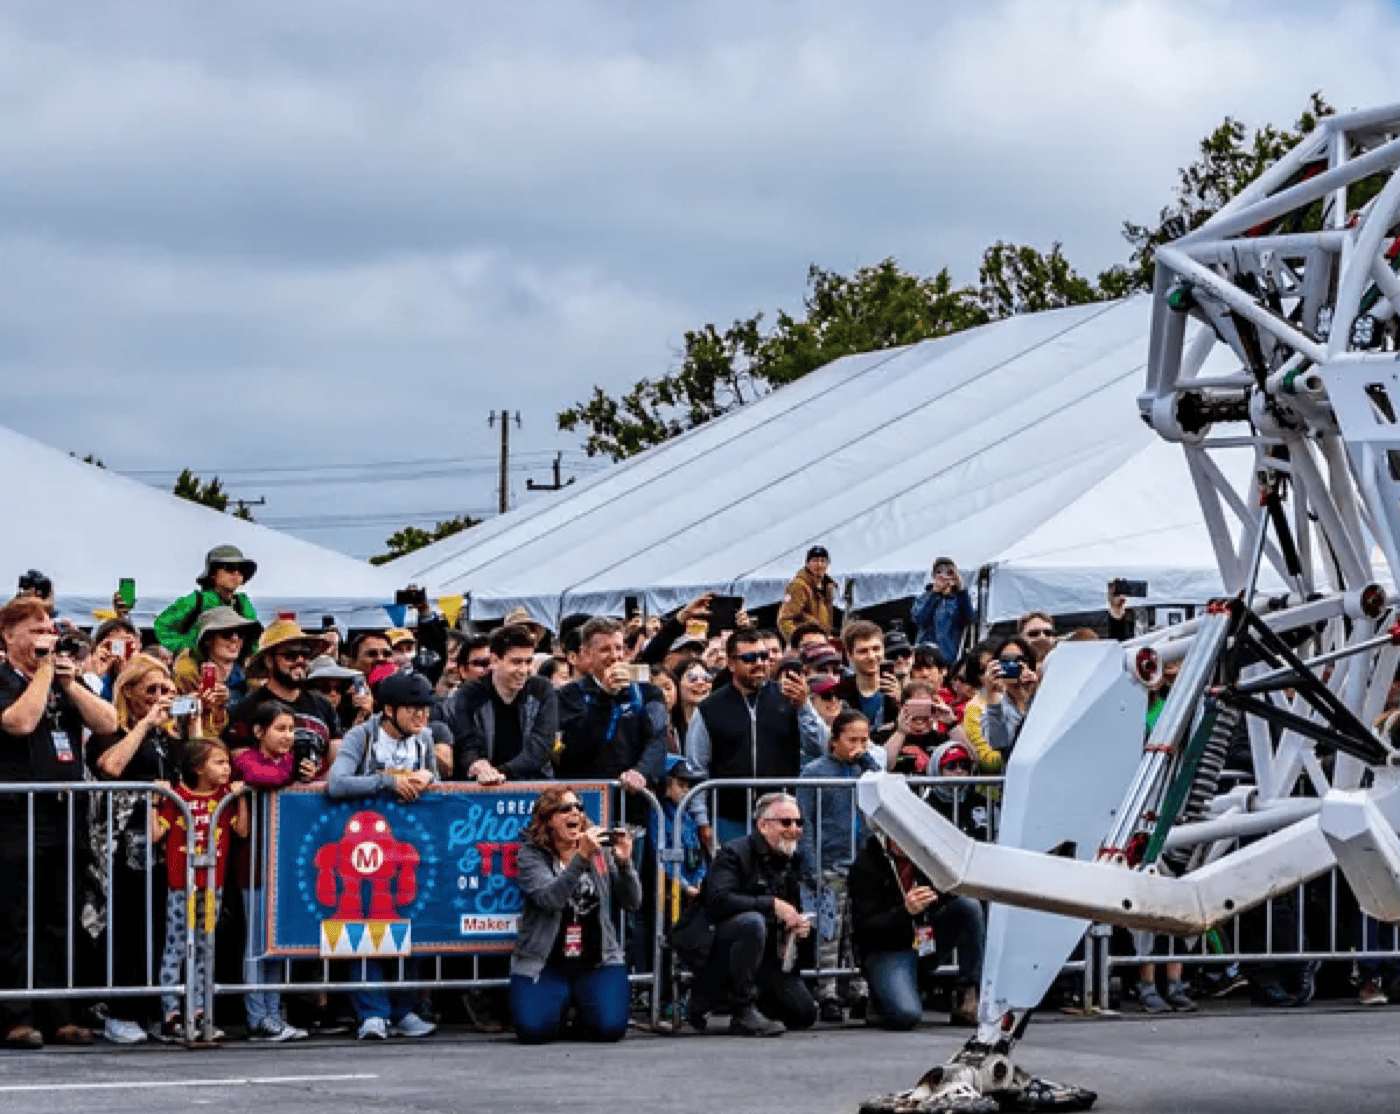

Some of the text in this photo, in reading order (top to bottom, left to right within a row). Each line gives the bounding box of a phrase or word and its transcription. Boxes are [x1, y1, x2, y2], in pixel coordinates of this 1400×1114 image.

[357, 848, 379, 868] M
[476, 842, 523, 877] TE
[457, 875, 479, 889] ON
[464, 918, 511, 932] Maker
